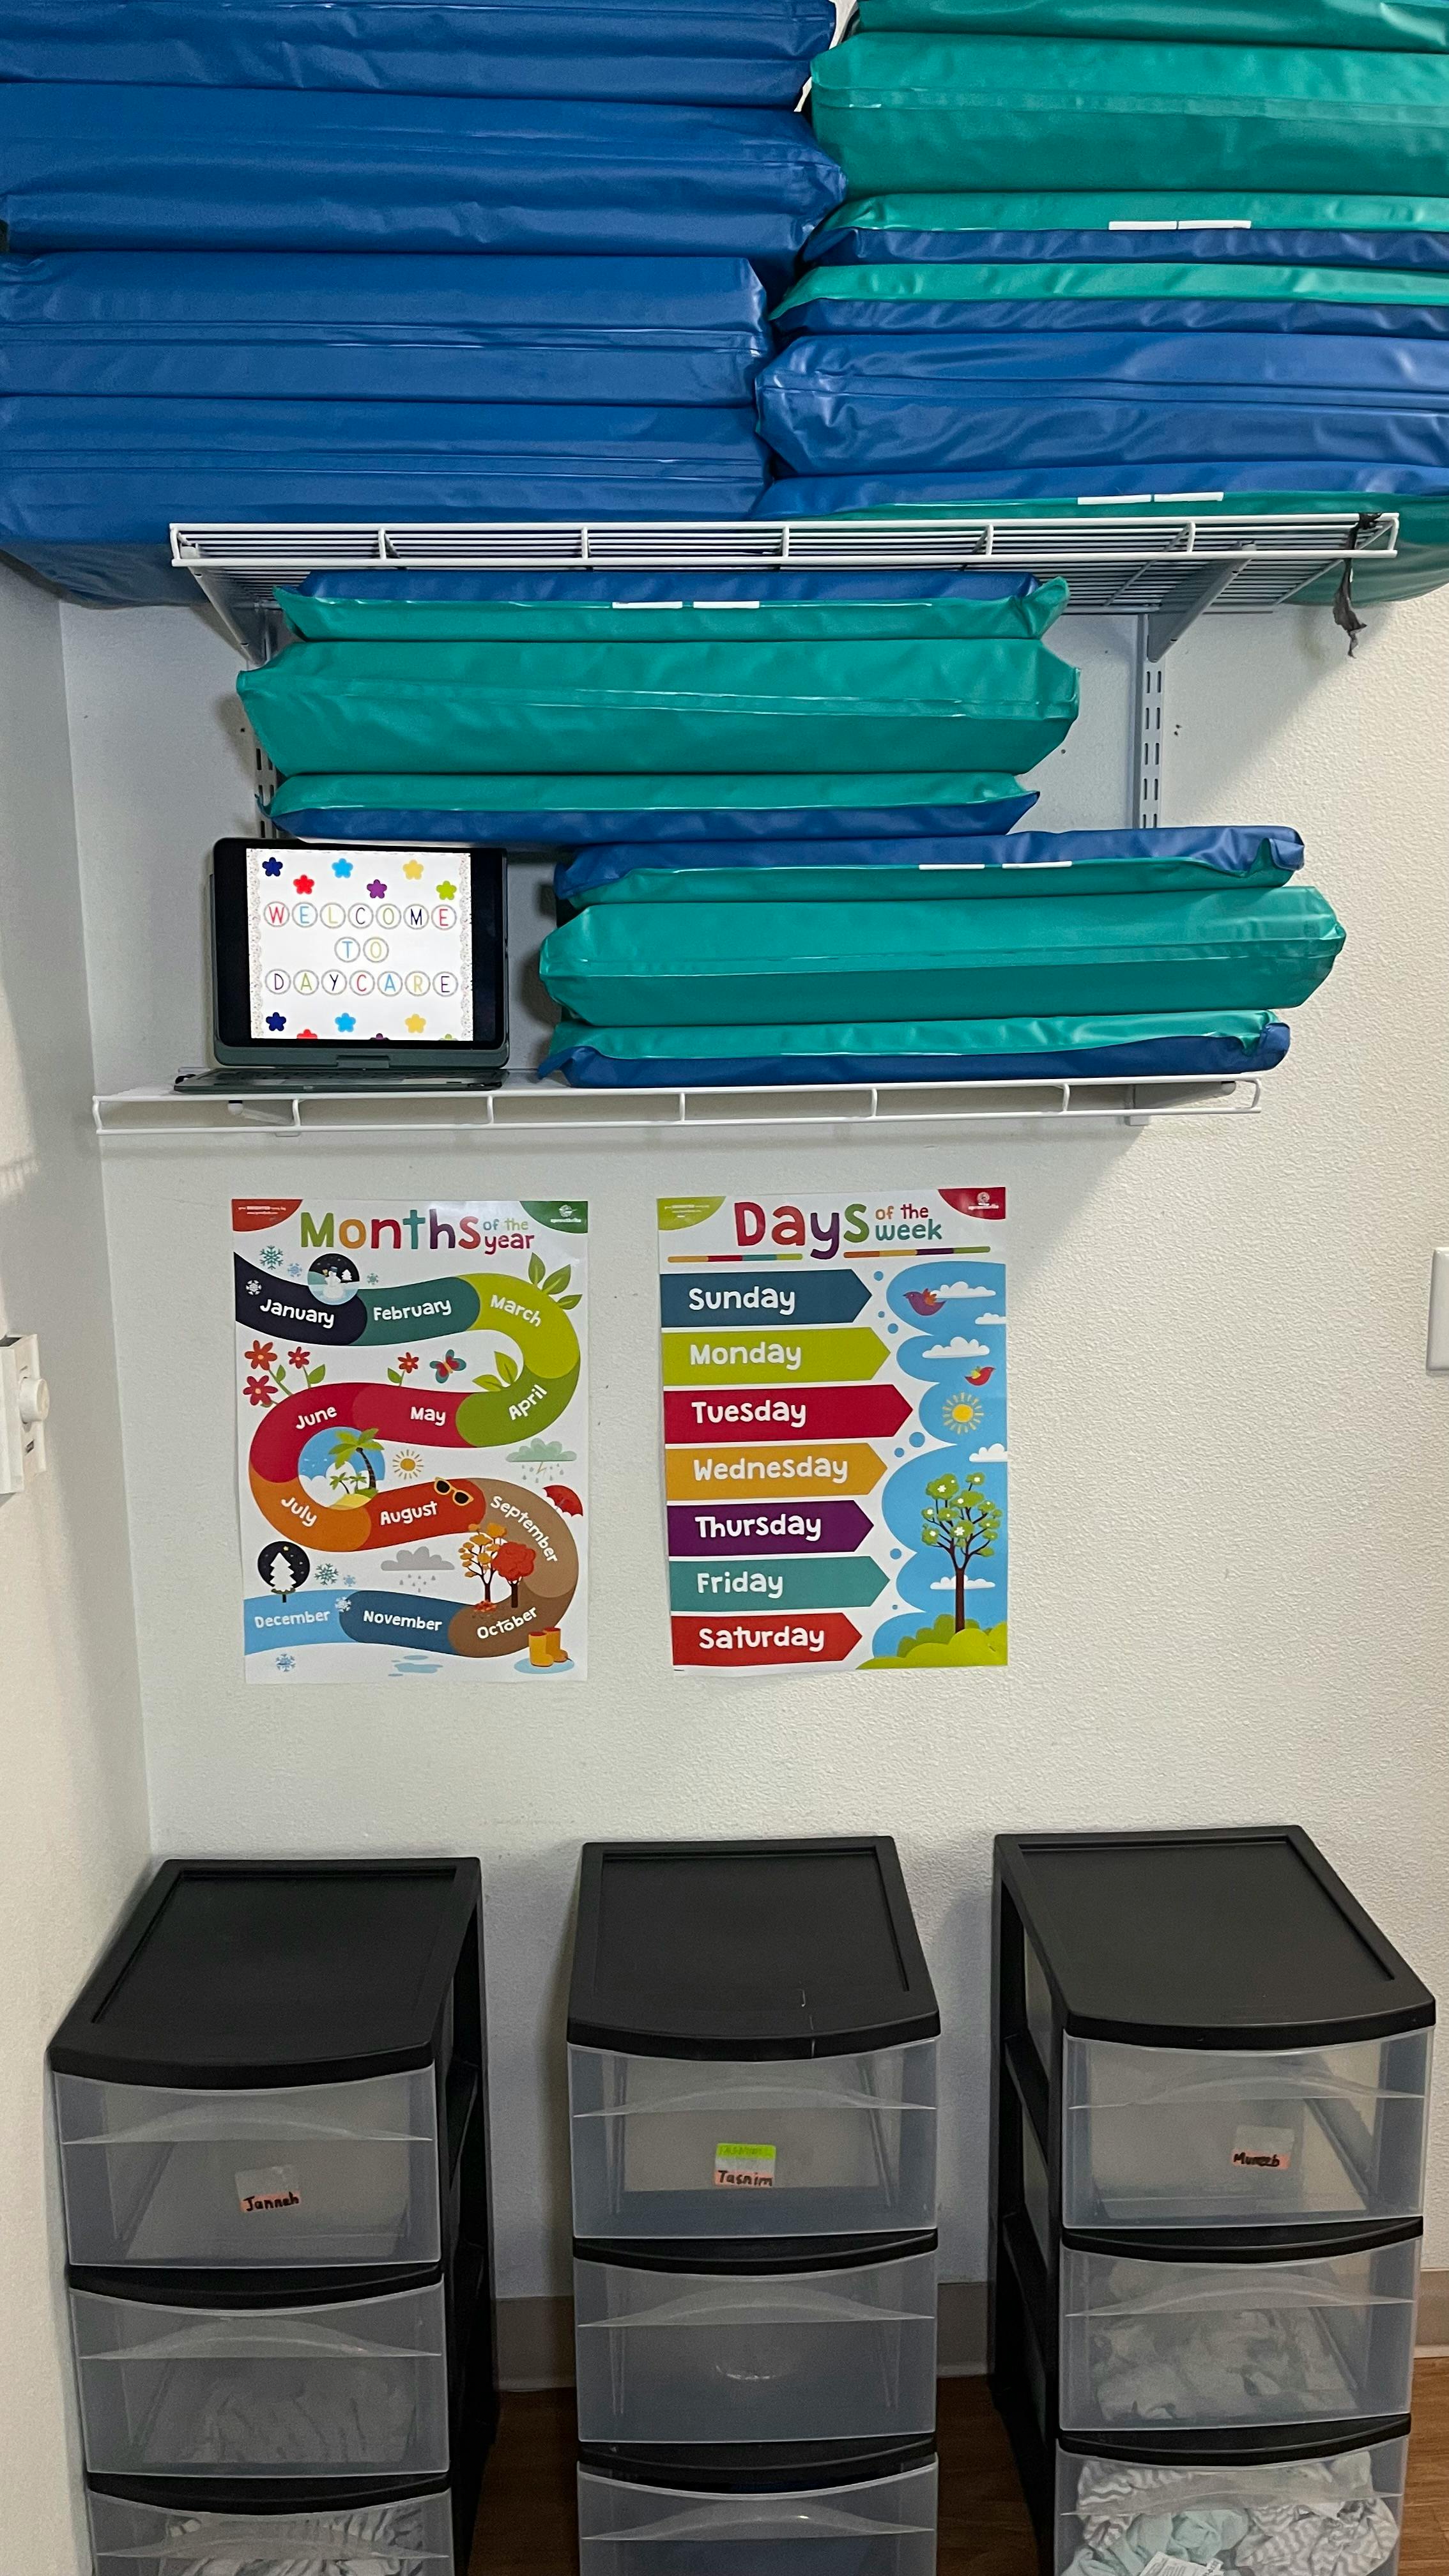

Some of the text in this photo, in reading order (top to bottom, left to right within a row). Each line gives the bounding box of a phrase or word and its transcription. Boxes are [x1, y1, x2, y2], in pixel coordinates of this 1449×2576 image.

[268, 906, 448, 927] WELCOME
[341, 940, 383, 960] TO
[274, 973, 450, 993] DAYCARE
[300, 1208, 529, 1250] Months of the
[484, 1232, 535, 1255] year
[734, 1201, 929, 1261] Days of the
[875, 1218, 942, 1241] week
[259, 1298, 335, 1328] January
[373, 1298, 452, 1322] February
[489, 1294, 542, 1327] March
[689, 1286, 796, 1315] Sunday
[690, 1342, 802, 1371] Monday
[410, 1406, 447, 1427] May
[507, 1384, 548, 1421] April
[691, 1400, 807, 1429] Tuesday
[295, 1405, 337, 1430] June
[693, 1455, 849, 1484] Wednesday
[280, 1496, 318, 1528] July
[379, 1501, 438, 1526] August
[489, 1495, 559, 1563] September
[694, 1513, 822, 1542] Thursday
[696, 1570, 784, 1599] Friday
[254, 1609, 330, 1629] December
[363, 1610, 443, 1632] November
[476, 1606, 539, 1640] October
[698, 1626, 825, 1653] Saturday
